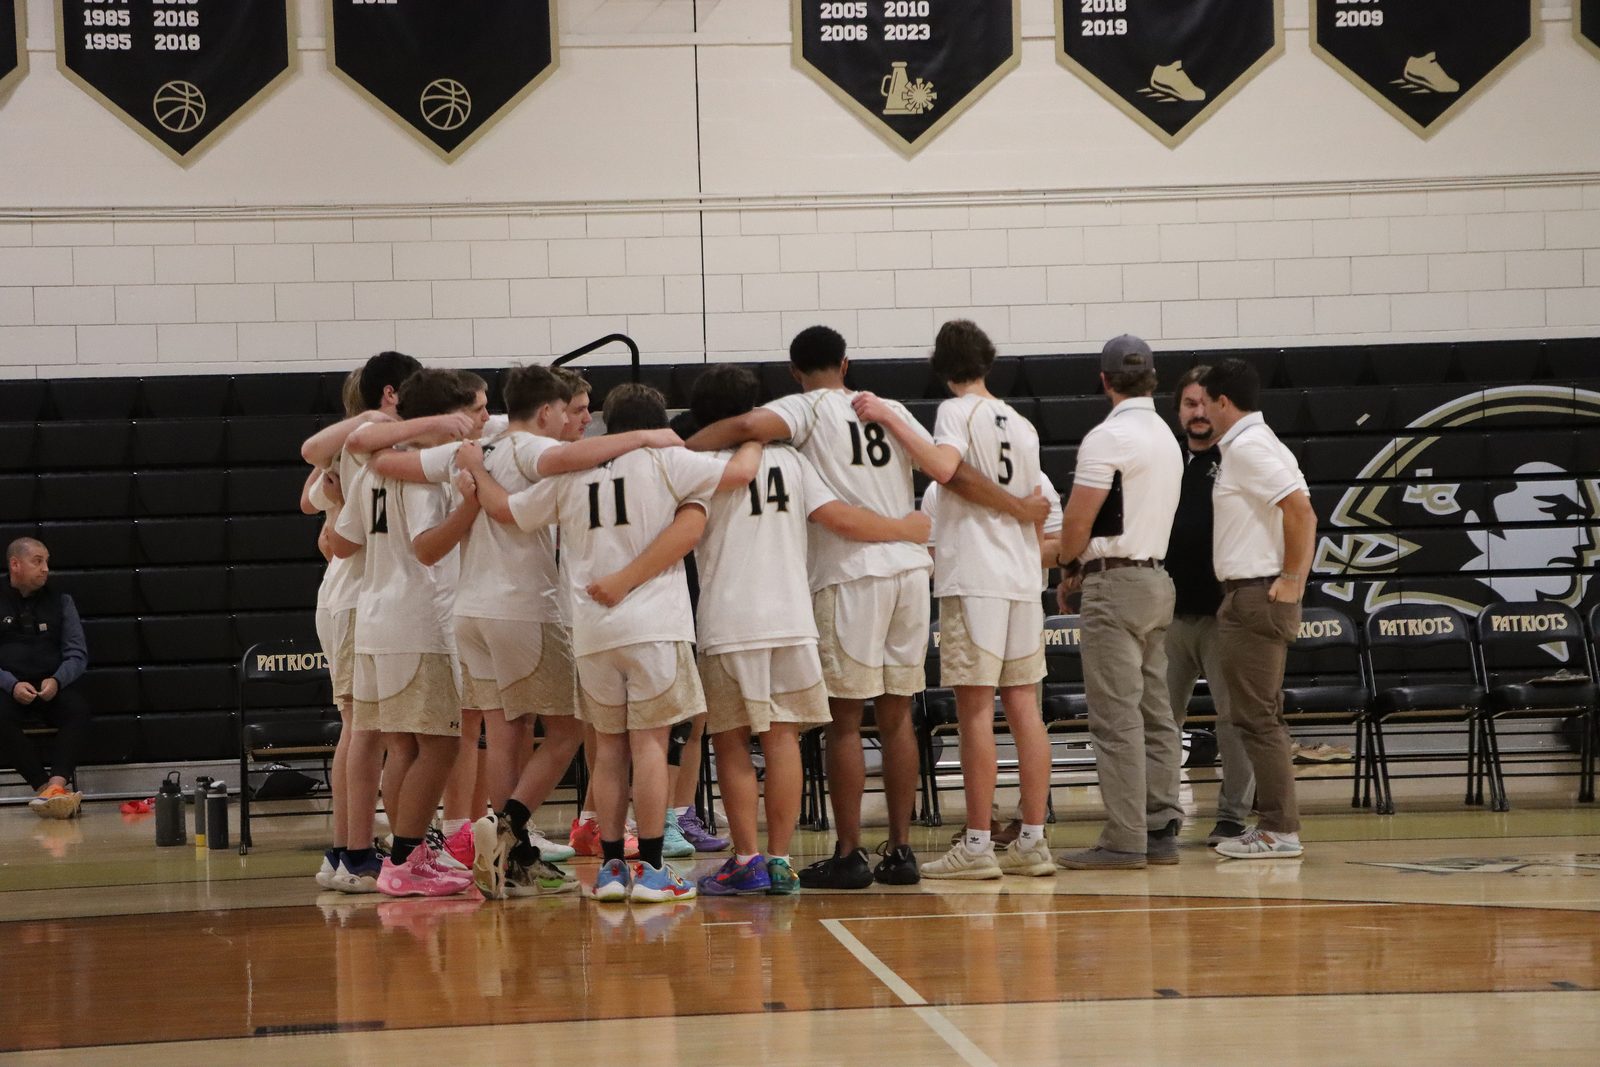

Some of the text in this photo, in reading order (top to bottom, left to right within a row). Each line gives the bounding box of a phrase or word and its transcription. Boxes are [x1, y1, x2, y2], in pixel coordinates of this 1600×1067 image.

[820, 1, 930, 19] 2005 2010
[1081, 0, 1127, 13] 2018
[83, 9, 199, 27] 1985 2016
[1335, 10, 1383, 27] 2009
[820, 24, 930, 41] 2006 2023
[1081, 19, 1127, 36] 2019
[84, 33, 200, 50] 1995 2018
[847, 420, 891, 467] 18
[998, 442, 1013, 485] 5
[749, 466, 790, 516] 14
[586, 477, 631, 530] 11
[1297, 620, 1342, 638] RIOTS
[1379, 617, 1454, 636] PATRIOTS
[1491, 613, 1568, 632] PATRIOTS
[1044, 628, 1080, 646] PATR
